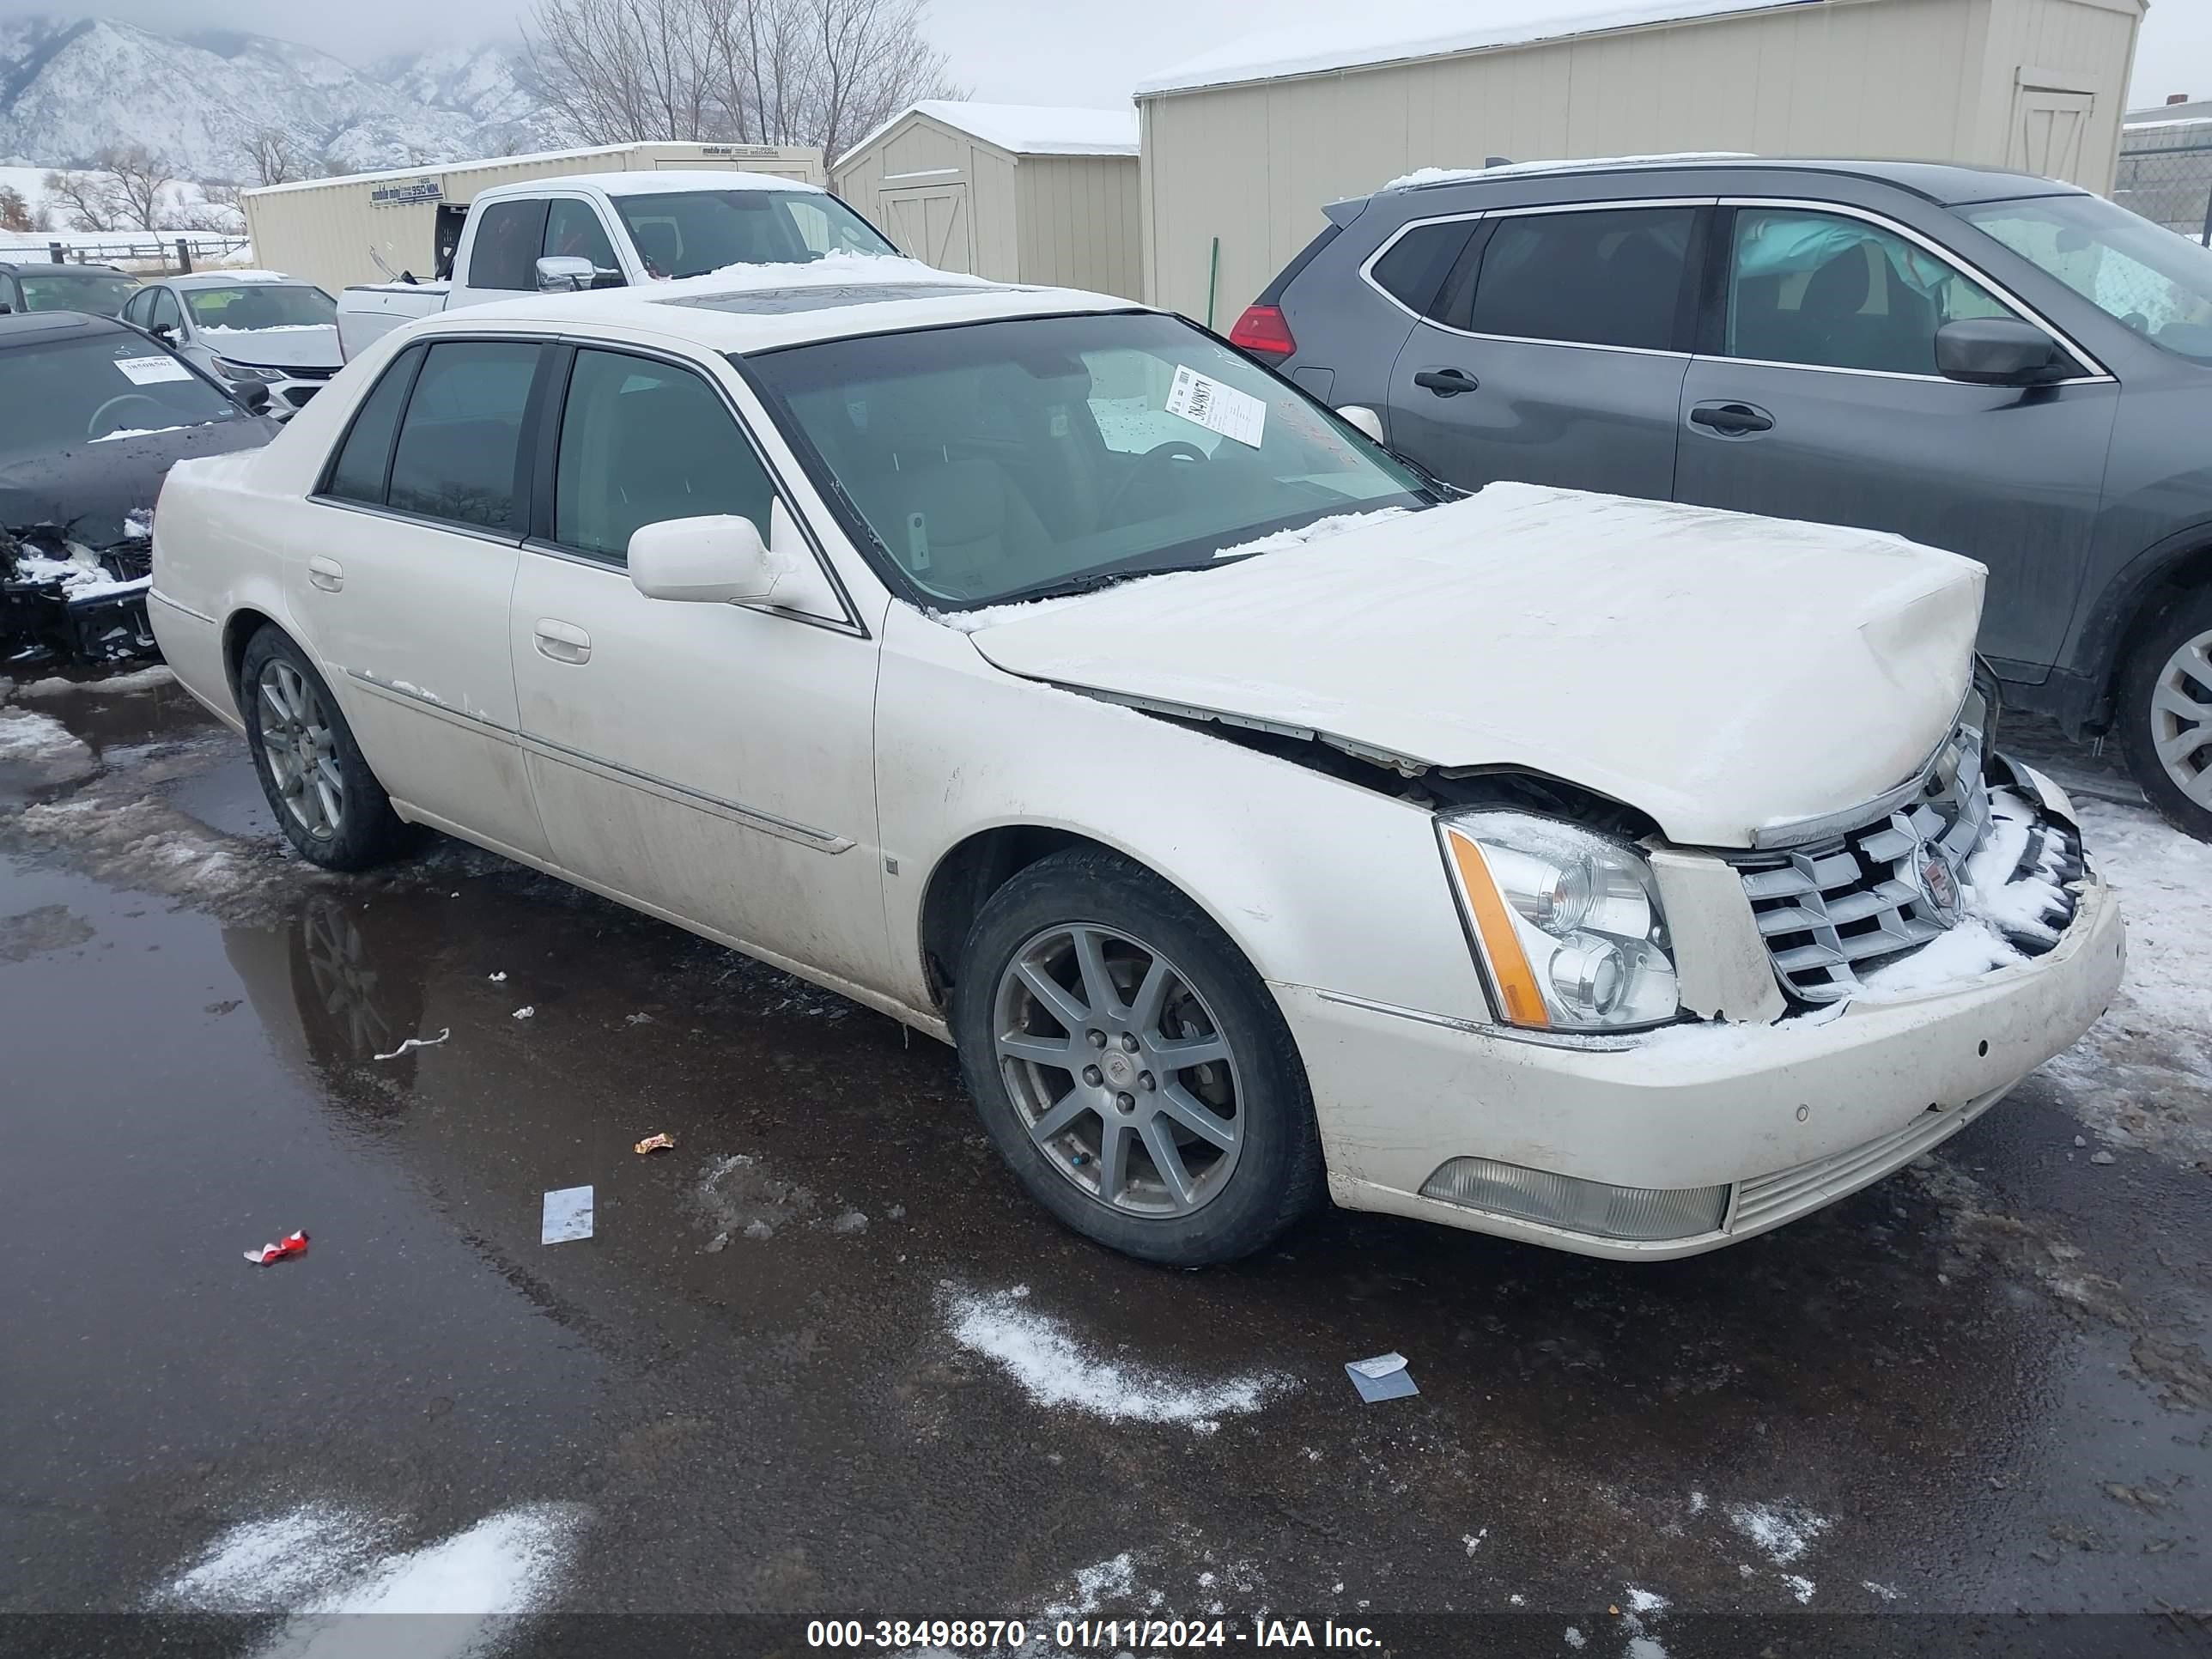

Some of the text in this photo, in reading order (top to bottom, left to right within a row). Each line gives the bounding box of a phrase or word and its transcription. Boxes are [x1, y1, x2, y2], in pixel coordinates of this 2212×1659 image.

[372, 184, 401, 201] mobile mini
[412, 183, 440, 196] 950-MINI
